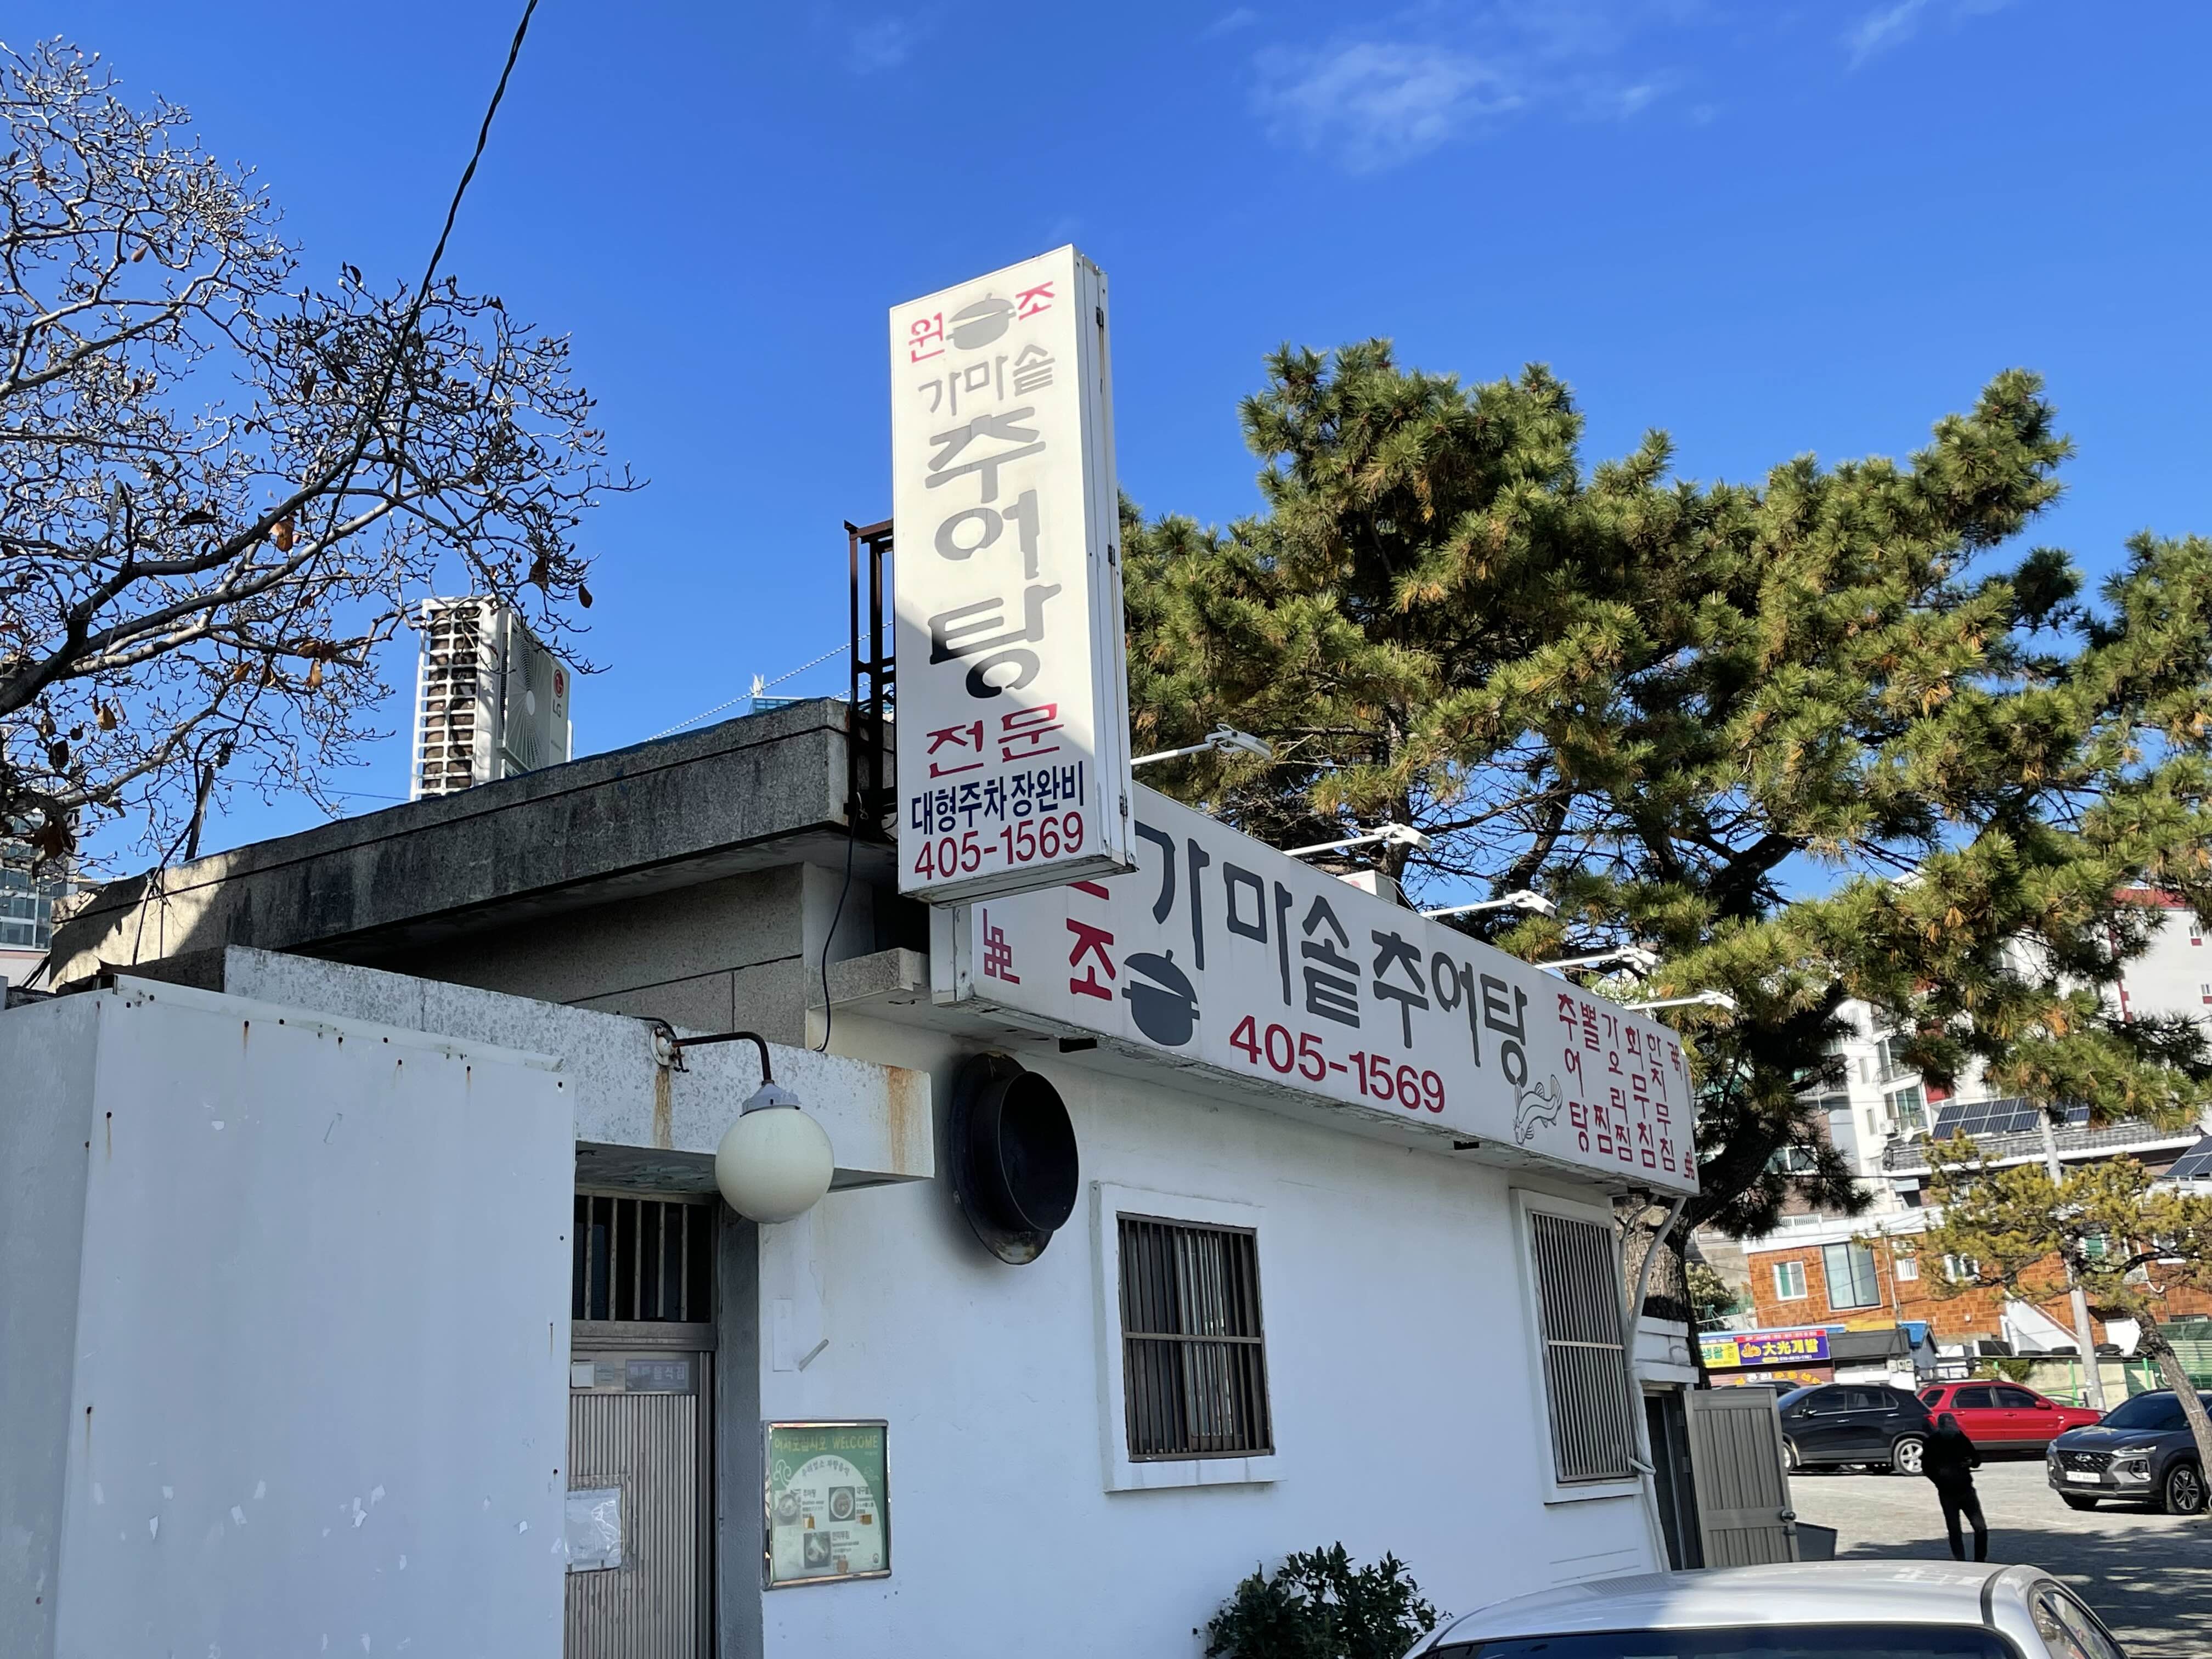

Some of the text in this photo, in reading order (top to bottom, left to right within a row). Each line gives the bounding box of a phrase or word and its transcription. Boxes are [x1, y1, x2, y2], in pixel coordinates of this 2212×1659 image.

[909, 281, 1055, 363] 원 조
[918, 344, 1056, 416] 가마솥
[925, 407, 1062, 699] 추어탕
[553, 698, 562, 718] LG
[927, 703, 1064, 778] 전문
[911, 760, 1085, 835] 대형주차장완비
[915, 811, 1084, 880] 405-1569
[1229, 1014, 1445, 1114] 405-1569
[1558, 993, 1589, 1153] 추어탕
[1601, 1013, 1633, 1163] 가오리찜
[1625, 1025, 1656, 1169] 회무침
[1646, 1032, 1675, 1172] 한치무침
[833, 1435, 878, 1449] WELCOME
